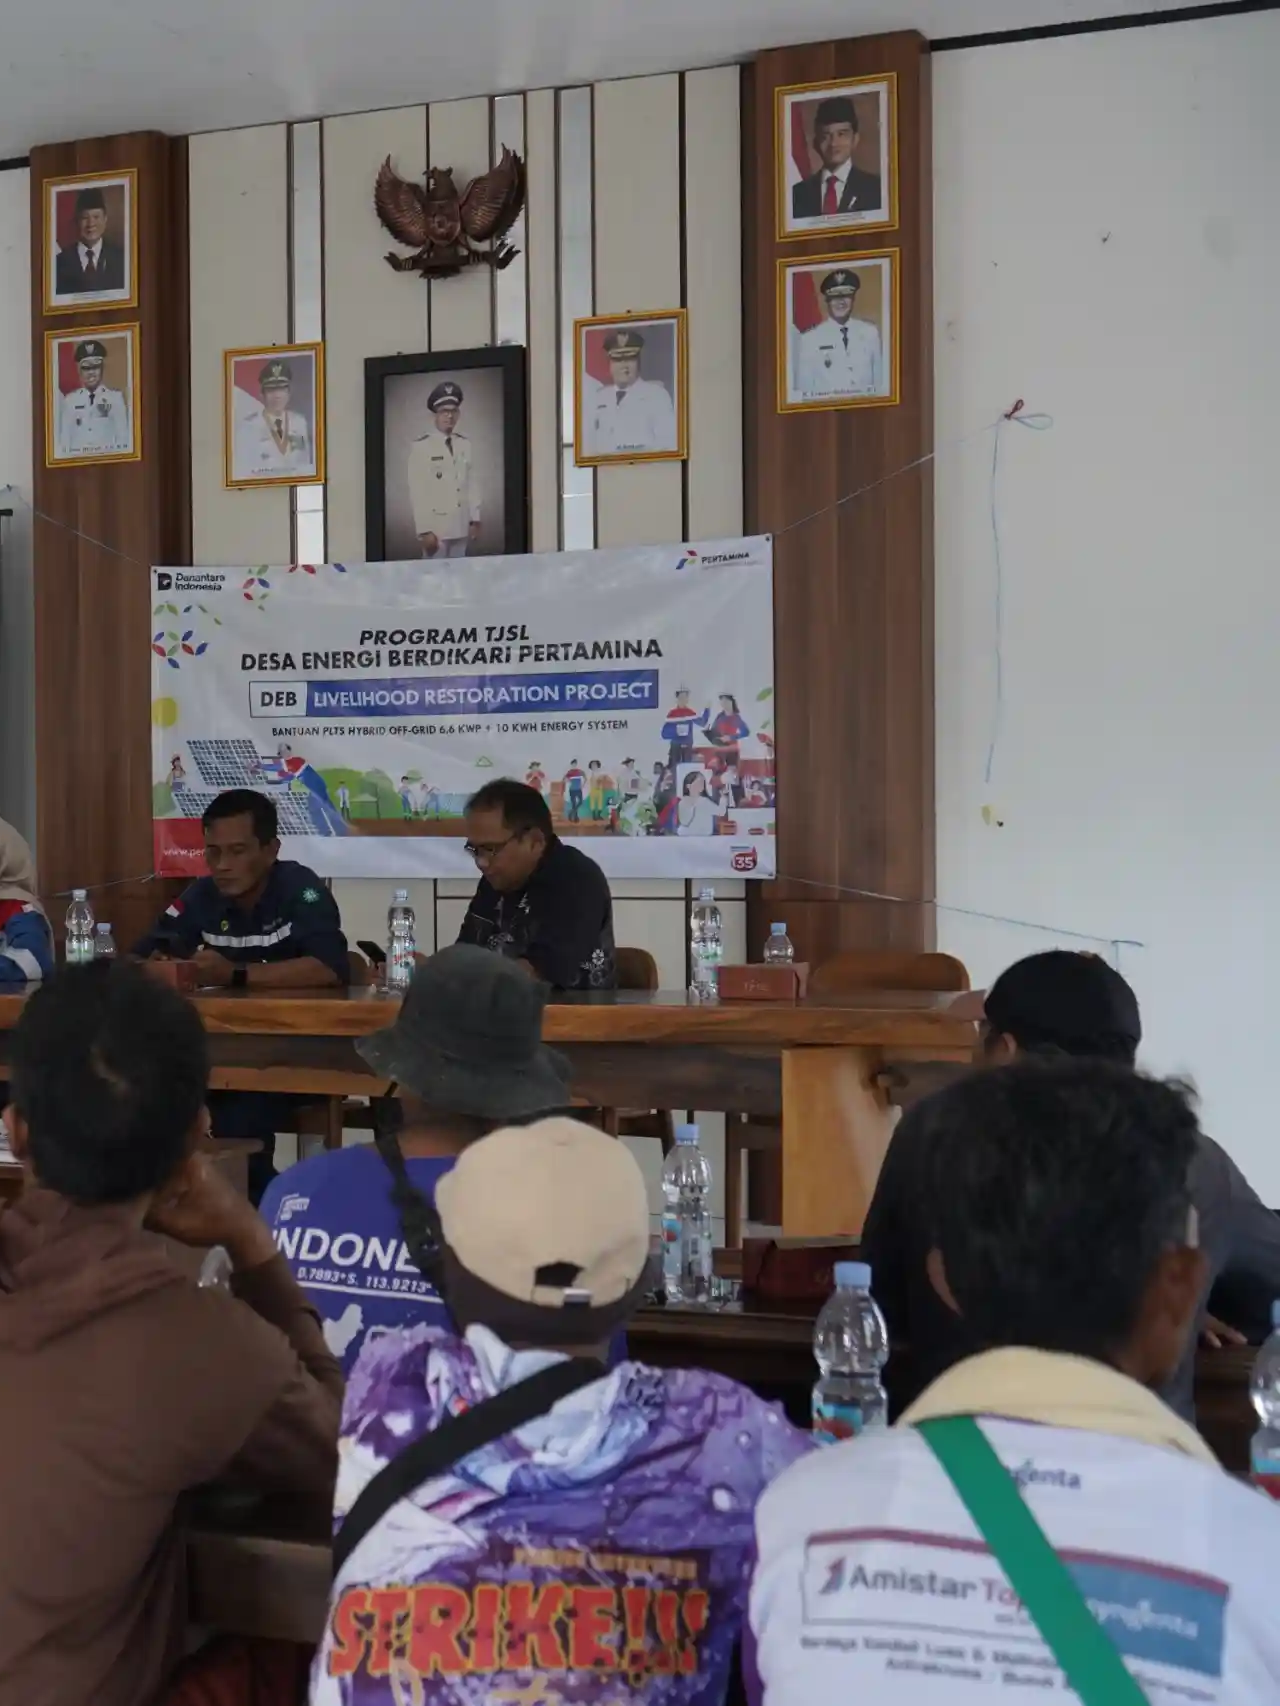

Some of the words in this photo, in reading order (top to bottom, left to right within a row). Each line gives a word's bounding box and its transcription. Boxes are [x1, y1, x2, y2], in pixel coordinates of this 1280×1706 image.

[175, 582, 222, 591] Indonesia
[176, 573, 225, 582] Danantara
[360, 627, 478, 646] PROGRAM
[485, 625, 529, 642] TJSL
[241, 651, 297, 671] DESA
[302, 650, 381, 670] ENERGI
[388, 646, 512, 667] BERDIKARI
[518, 639, 663, 663] PERTAMINA
[260, 691, 297, 707] DEB
[313, 690, 420, 708] LIVELIHOOD
[424, 684, 560, 706] RESTORATION
[565, 682, 653, 700] PROJECT
[272, 726, 320, 737] BANTUAN
[323, 726, 345, 736] PLTS
[348, 726, 385, 736] HYBRID
[389, 725, 437, 736] OFF-GRID
[458, 724, 482, 734] KWP
[497, 723, 509, 733] 10
[512, 723, 537, 733] KWH
[541, 721, 585, 732] ENERGY
[587, 720, 628, 731] SYSTEM
[735, 856, 754, 869] 35
[849, 1563, 978, 1600] Amistar
